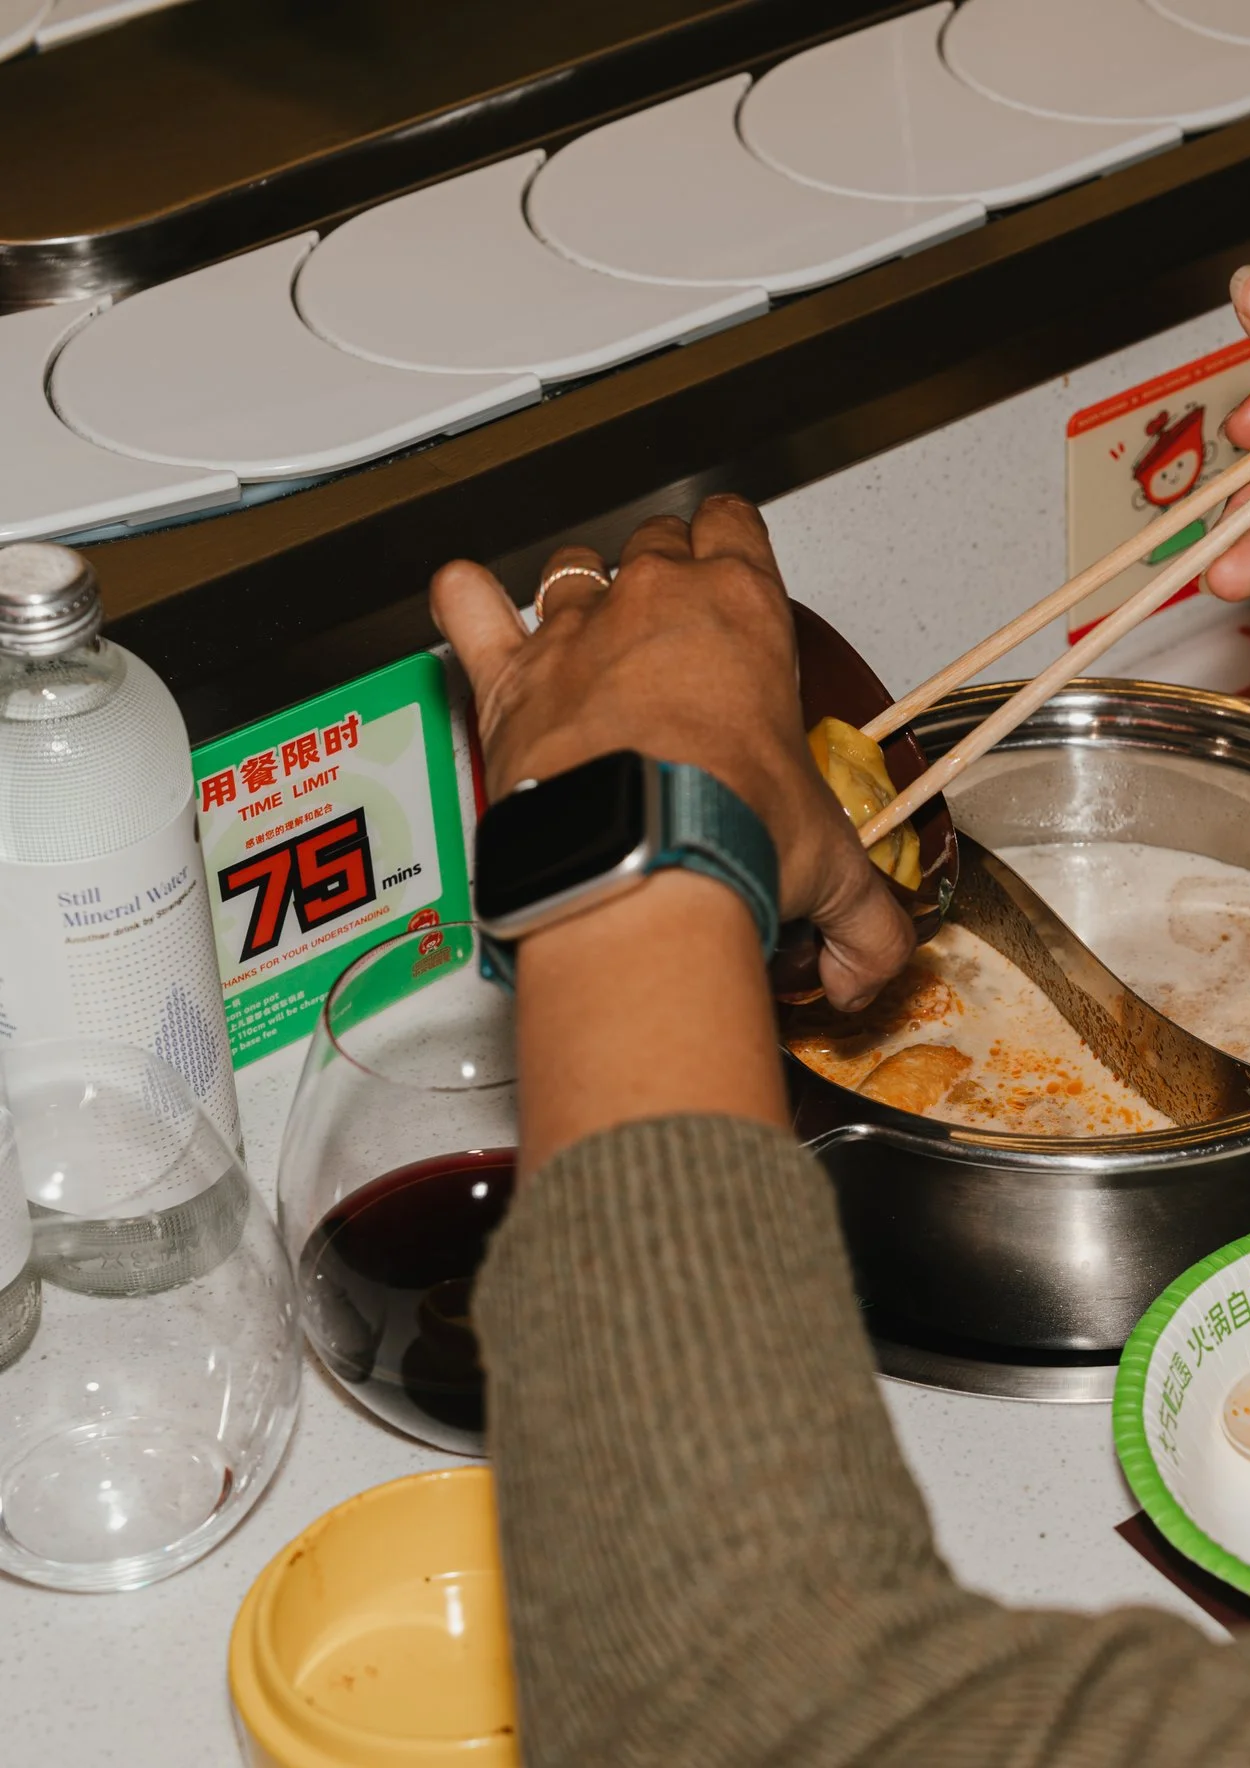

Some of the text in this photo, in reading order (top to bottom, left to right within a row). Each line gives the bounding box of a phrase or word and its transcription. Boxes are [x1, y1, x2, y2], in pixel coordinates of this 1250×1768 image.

[201, 715, 359, 812] 用餐限时
[237, 765, 340, 822] TIME LIMIT
[245, 803, 333, 849] 感谢您的理解和配合
[57, 887, 102, 908] Still
[62, 865, 188, 929] Mineral Water
[217, 806, 377, 964] 75
[382, 863, 422, 891] mins
[221, 905, 390, 989] THANKS FOR YOUR UNDERSTANDING
[237, 1022, 266, 1039] 110cm
[268, 1012, 285, 1026] will
[286, 1006, 298, 1017] be
